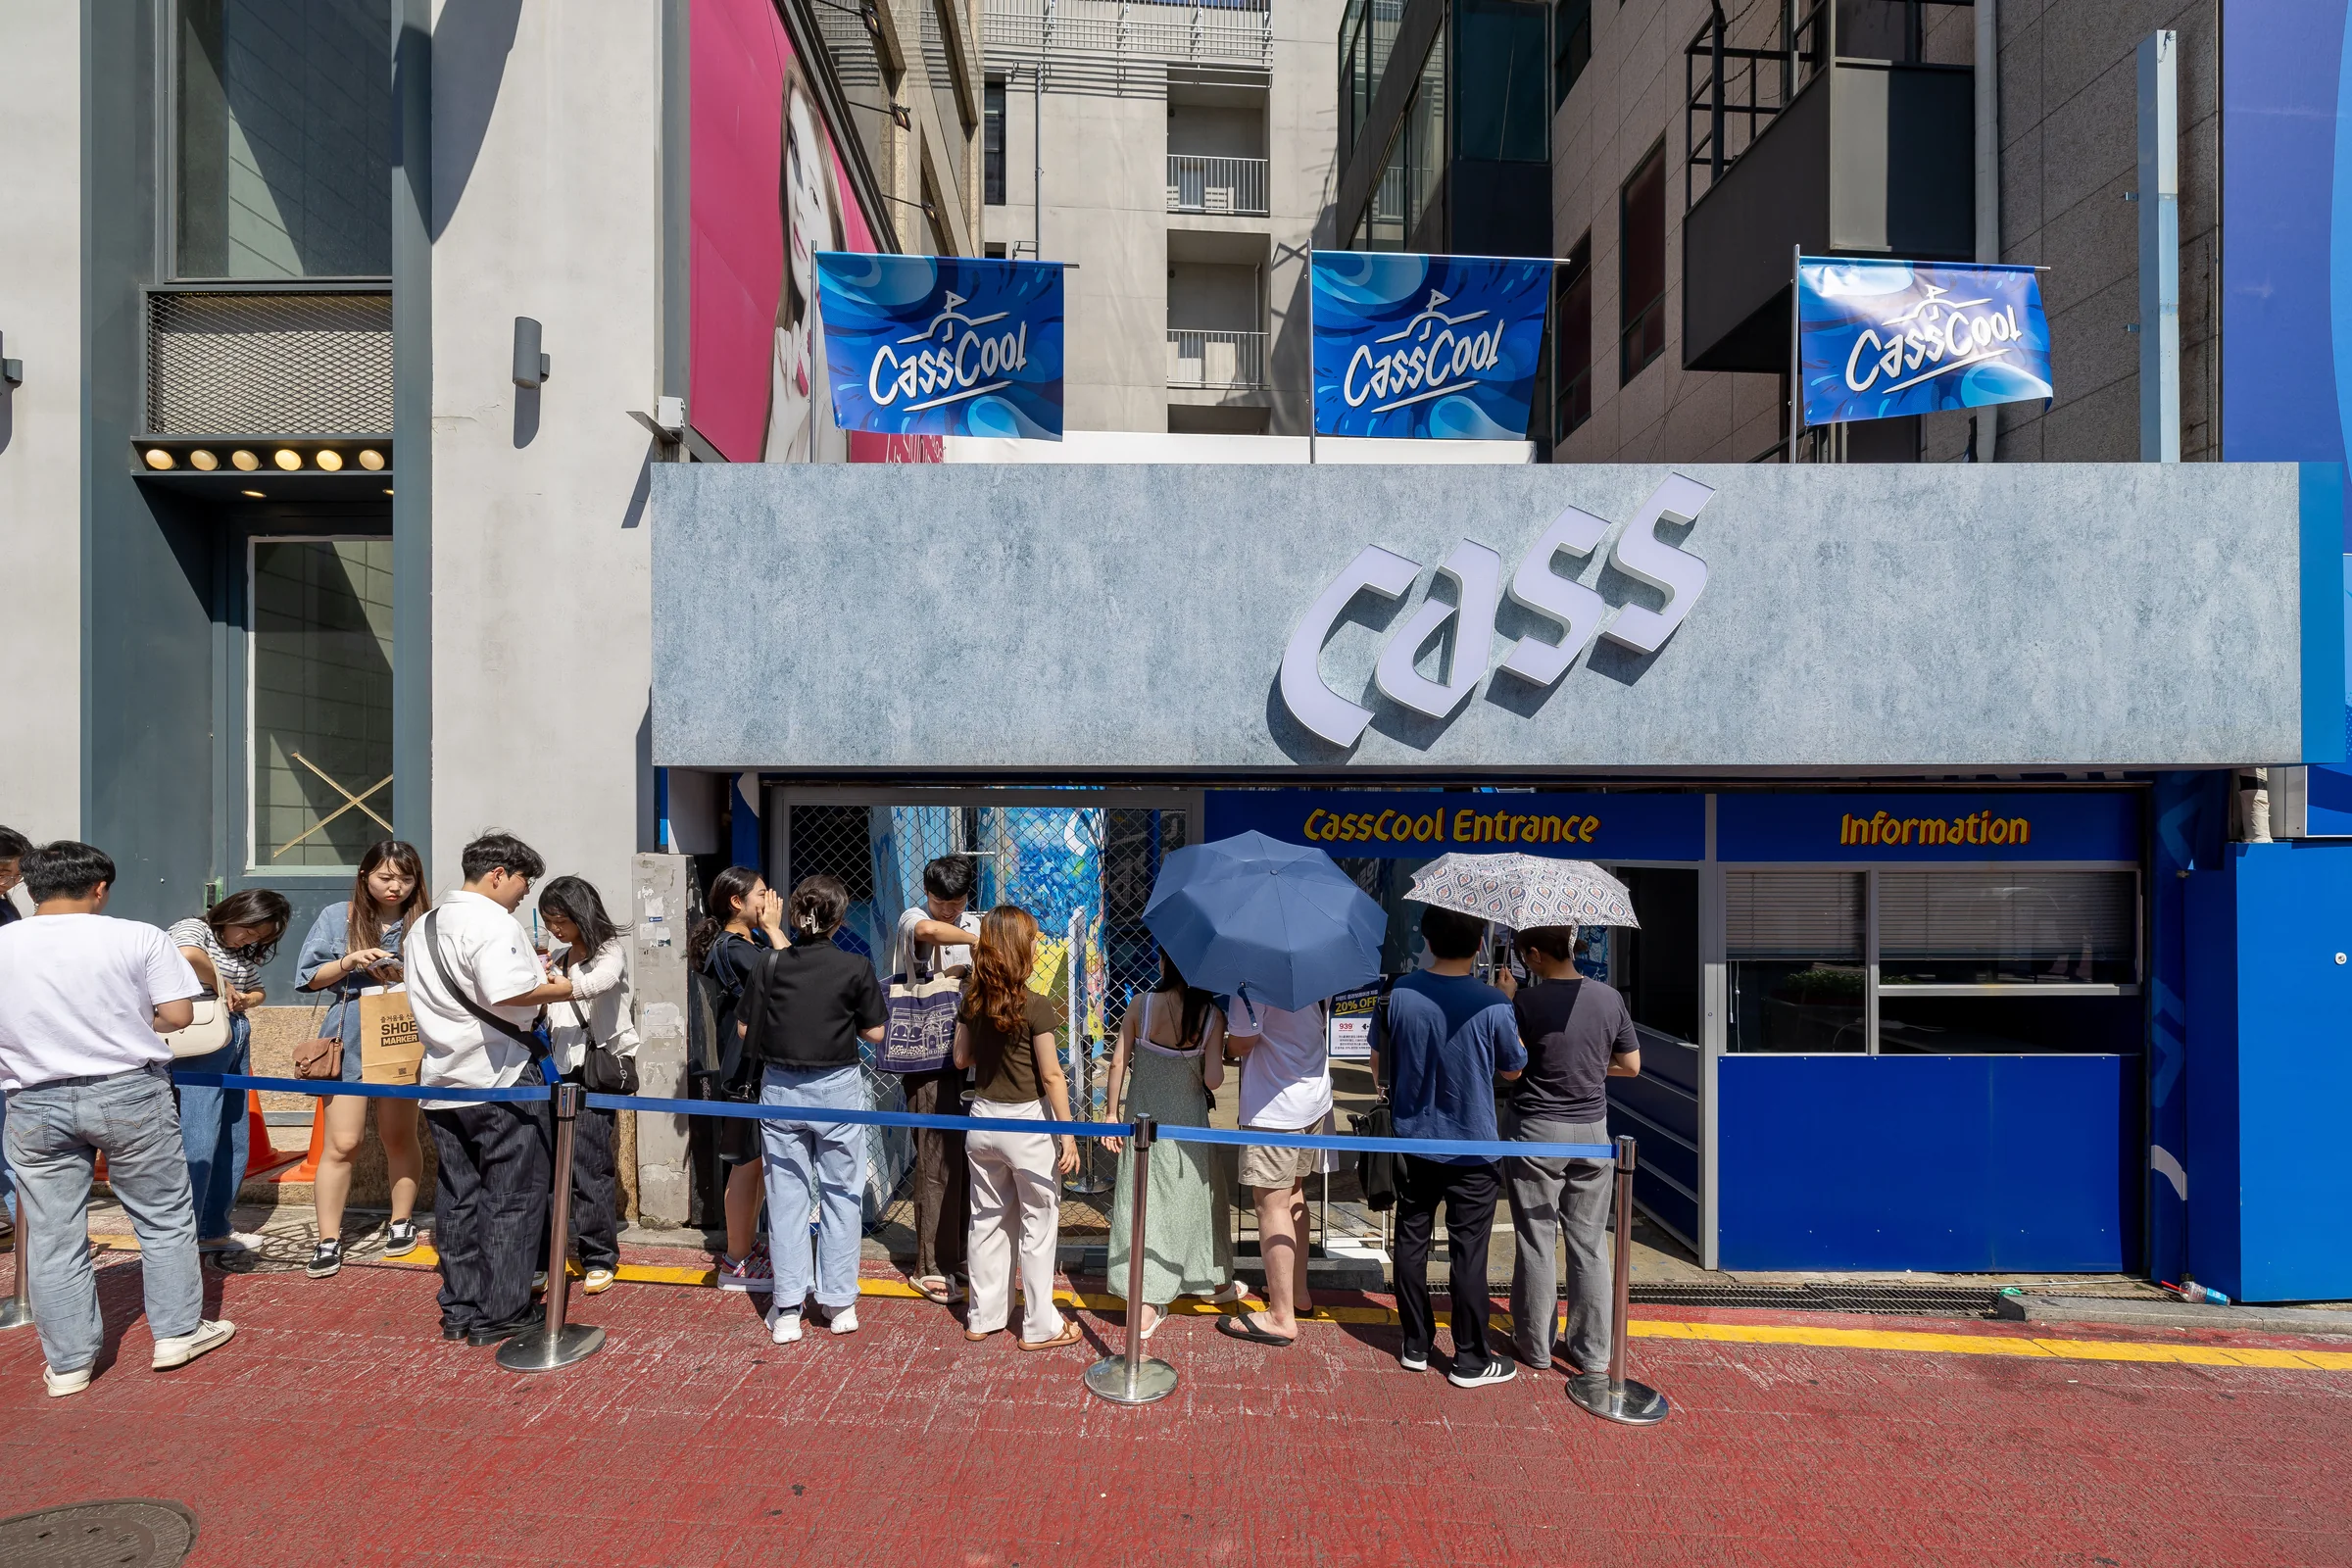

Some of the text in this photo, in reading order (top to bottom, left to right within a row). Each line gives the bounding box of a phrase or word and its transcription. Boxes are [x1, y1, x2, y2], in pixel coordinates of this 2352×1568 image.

[868, 320, 1027, 406] CassCool
[1344, 318, 1505, 408] CassCool
[1845, 304, 2023, 392] CassCool
[1303, 807, 1601, 844] CassCool Entrance
[1840, 809, 2032, 846] Information
[1335, 996, 1379, 1013] 20% OFF
[381, 1020, 418, 1035] SHOE
[382, 1034, 417, 1046] MARKER
